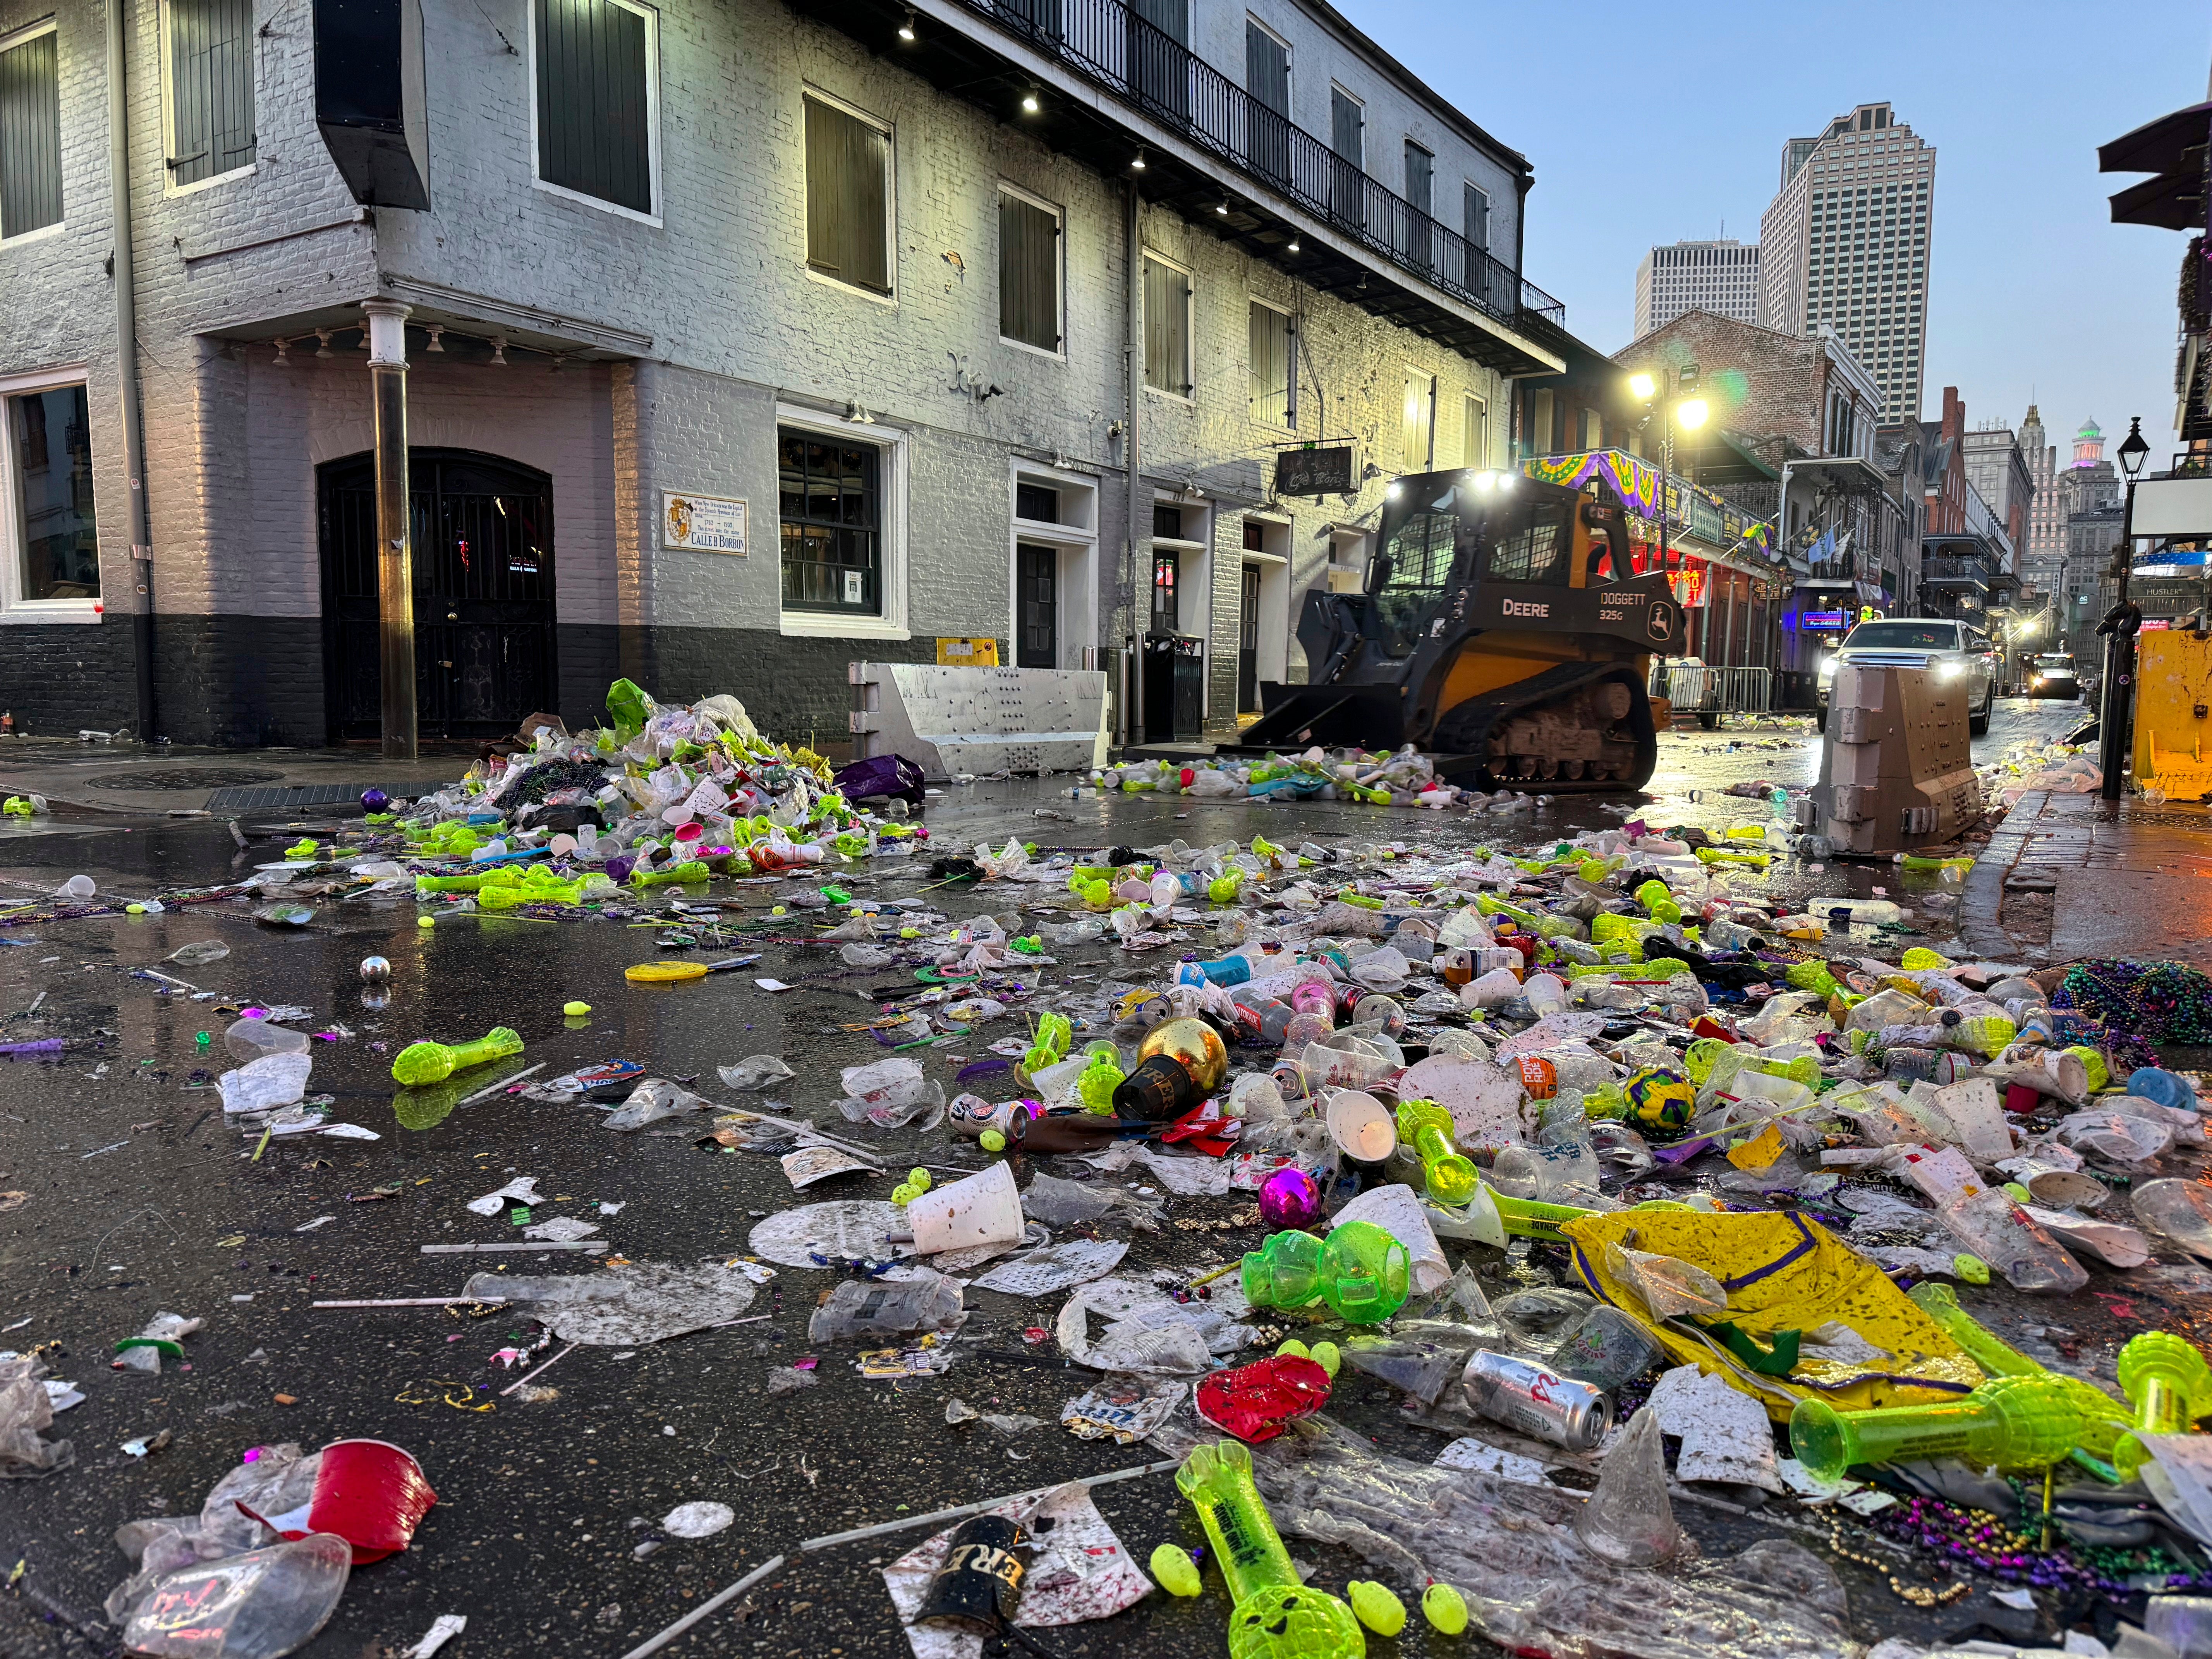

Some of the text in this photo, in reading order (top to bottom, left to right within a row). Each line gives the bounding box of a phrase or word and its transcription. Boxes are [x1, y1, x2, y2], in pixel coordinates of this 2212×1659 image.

[692, 532, 712, 546] CALLE
[720, 535, 744, 549] BORBON
[1601, 592, 1646, 605] DOGGETT
[1503, 599, 1549, 617] DEERE
[1599, 610, 1623, 620] 325G
[1578, 1339, 1606, 1359] CANTINA
